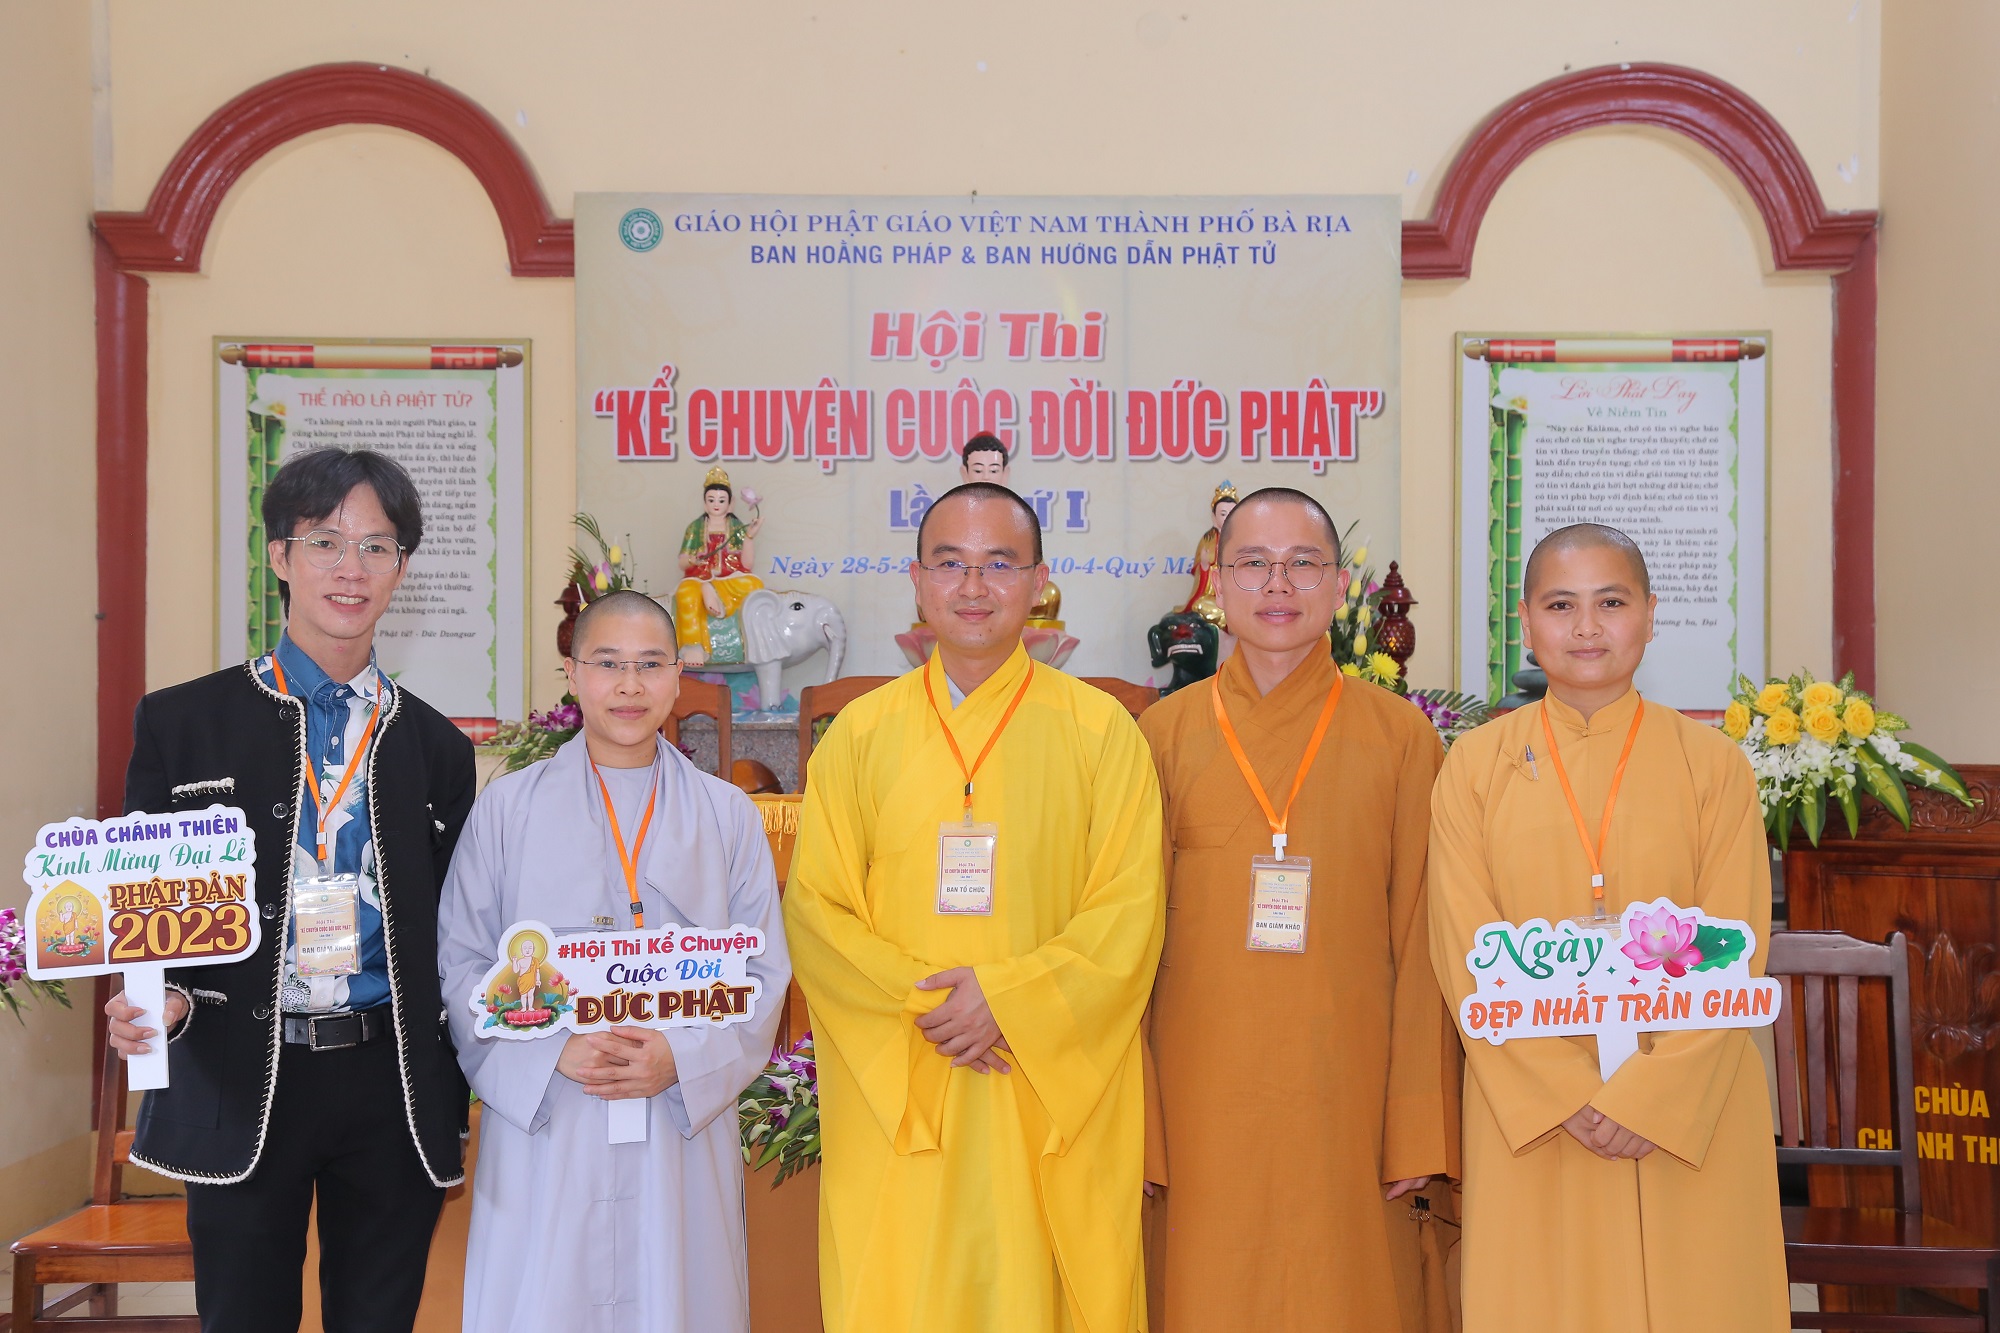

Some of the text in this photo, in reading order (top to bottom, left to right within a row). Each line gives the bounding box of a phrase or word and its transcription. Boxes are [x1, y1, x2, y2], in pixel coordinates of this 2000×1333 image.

[674, 210, 741, 232] GIÁO
[750, 209, 798, 237] HỘI
[807, 209, 879, 237] PHẬT
[886, 210, 952, 233] GIÁO
[959, 210, 1022, 237] VIỆT
[1029, 215, 1088, 233] NAM
[1096, 210, 1189, 233] THÀNH
[1198, 208, 1255, 233] PHỐ
[1262, 210, 1297, 233] BÀ
[1306, 215, 1351, 237] RỊA
[751, 240, 1277, 268] BAN HOẰNG PHÁP & BAN HƯỚNG DẪN PHẬT TỬ
[870, 310, 1102, 368] Hội Thi
[299, 387, 472, 410] THẾ NÀO LÀ PHẬT TỬ?
[1587, 407, 1666, 417] Về Niềm Tin
[594, 365, 674, 456] “KỂ
[688, 377, 867, 469] CHUYỆN
[1029, 378, 1109, 456] ĐỜI
[1126, 379, 1222, 457] ĐỨC
[1241, 378, 1377, 470] PHẬT”
[890, 484, 932, 527] Lầ
[1066, 491, 1084, 527] I
[769, 556, 1195, 578] Ngày 28-5-2 10-4-Quý Mã
[45, 814, 238, 848] CHÙA CHÁNH THIÊN
[33, 838, 248, 878] Kính Mừng Đại Lễ
[109, 870, 246, 910] PHẬT ĐẢN
[112, 905, 248, 960] 2023
[1269, 921, 1284, 929] GIÁM
[1285, 922, 1300, 931] KHẢO
[558, 931, 758, 962] #Hội Thi Kể Chuyện
[1474, 926, 1604, 980] Ngày
[606, 959, 724, 986] Cuộc Đời
[575, 980, 753, 1025] ĐỨC PHẬT
[1467, 977, 1773, 1037] ĐẸP NHẤT TRẦN GIAN
[1914, 1082, 1990, 1118] CHÙA
[1858, 1128, 1954, 1160] CHNH
